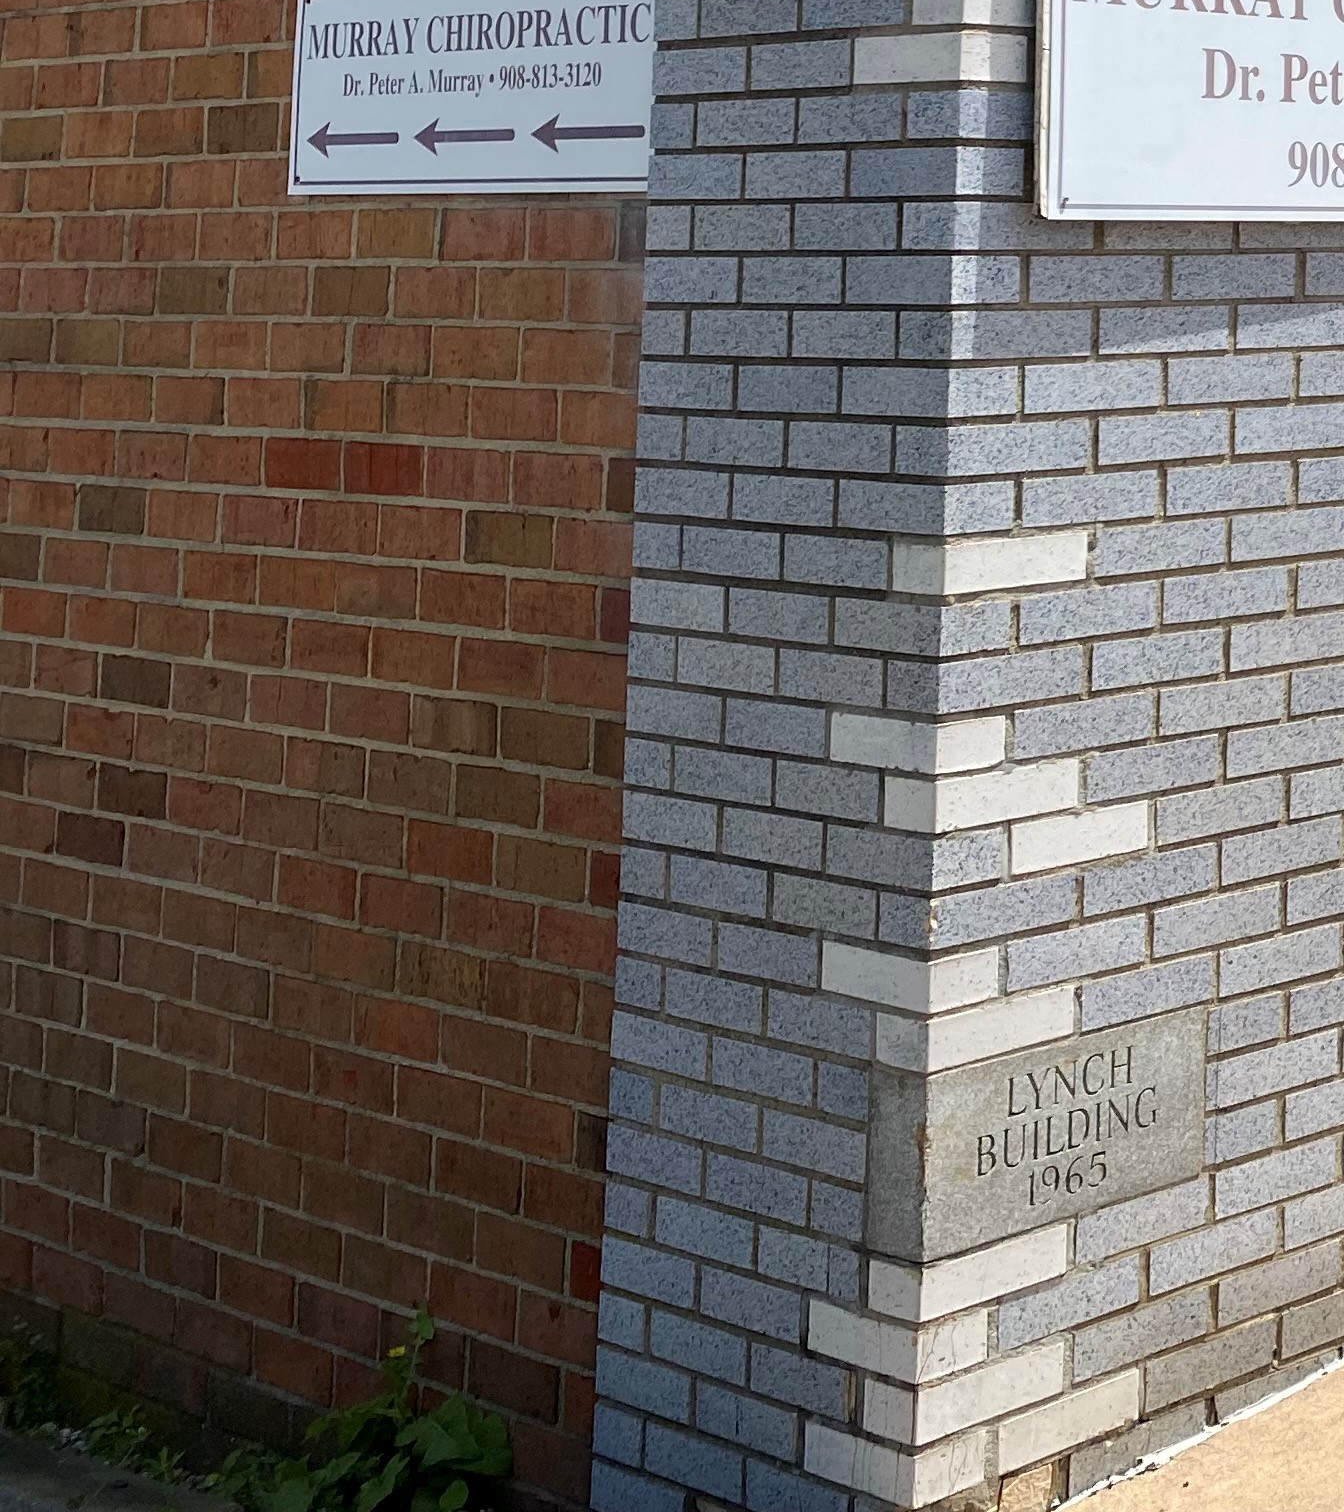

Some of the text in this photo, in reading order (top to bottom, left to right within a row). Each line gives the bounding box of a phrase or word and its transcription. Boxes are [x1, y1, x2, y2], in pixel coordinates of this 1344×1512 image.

[307, 2, 651, 60] MURRAY CHIROPRACTIC
[343, 62, 602, 98] Dr. Peter A. Murray 908-813-3120
[1201, 47, 1265, 102] Dr.
[1007, 1045, 1133, 1118] LYNCH
[976, 1085, 1158, 1177] BUILDING
[1028, 1151, 1107, 1206] 1965
